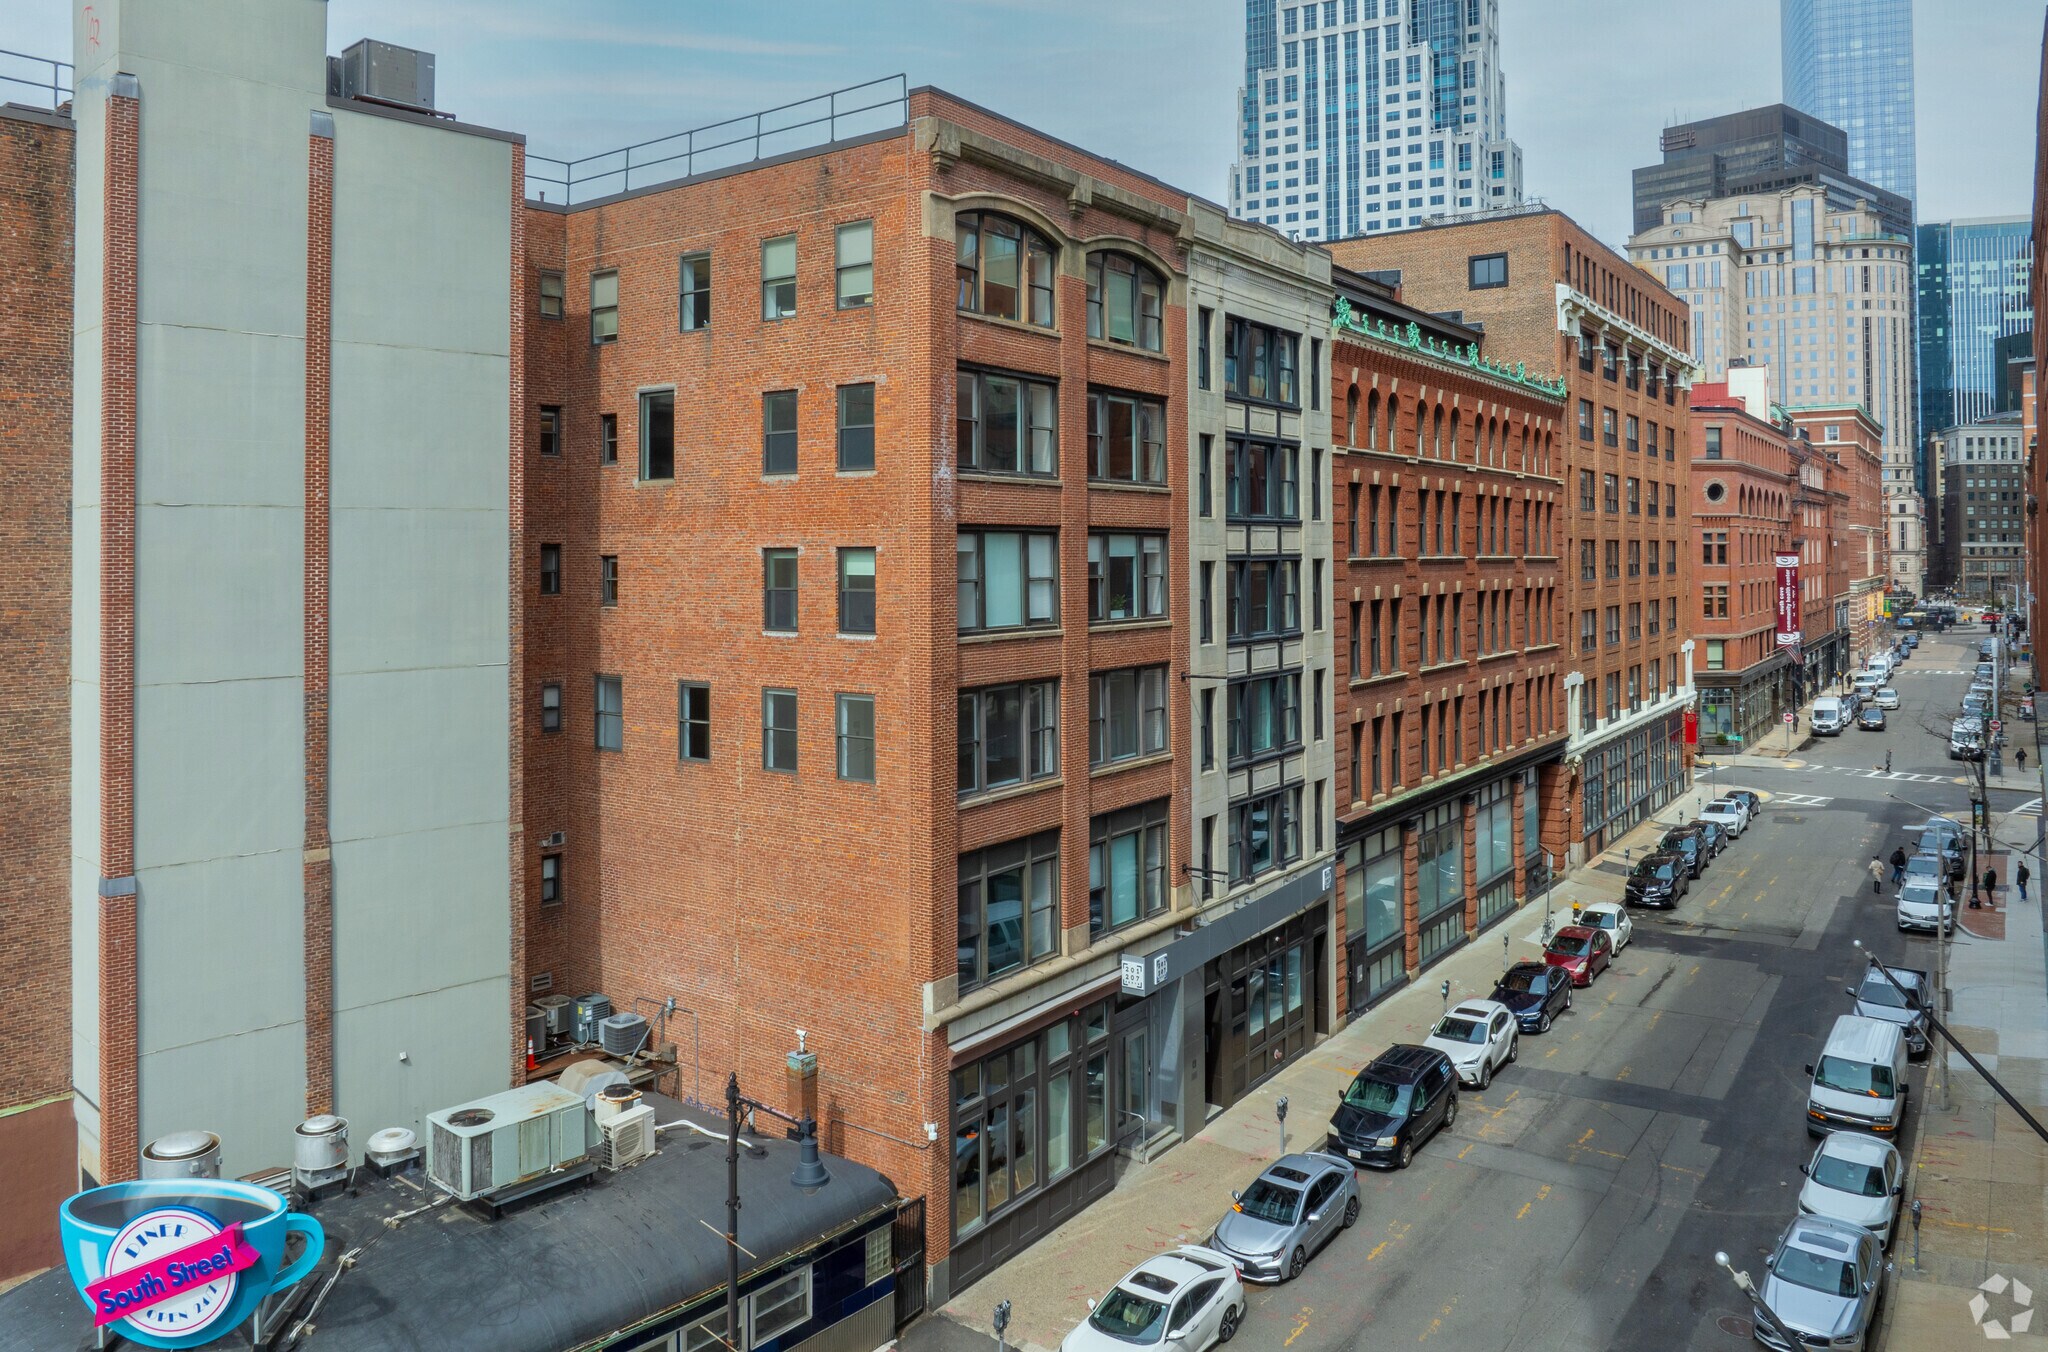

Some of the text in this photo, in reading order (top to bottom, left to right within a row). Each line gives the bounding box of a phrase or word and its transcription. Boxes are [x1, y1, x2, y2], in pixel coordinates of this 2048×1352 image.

[1125, 966, 1139, 975] 201
[124, 1223, 189, 1259] DINER
[98, 1245, 235, 1314] South Street
[146, 1309, 188, 1323] OPEN
